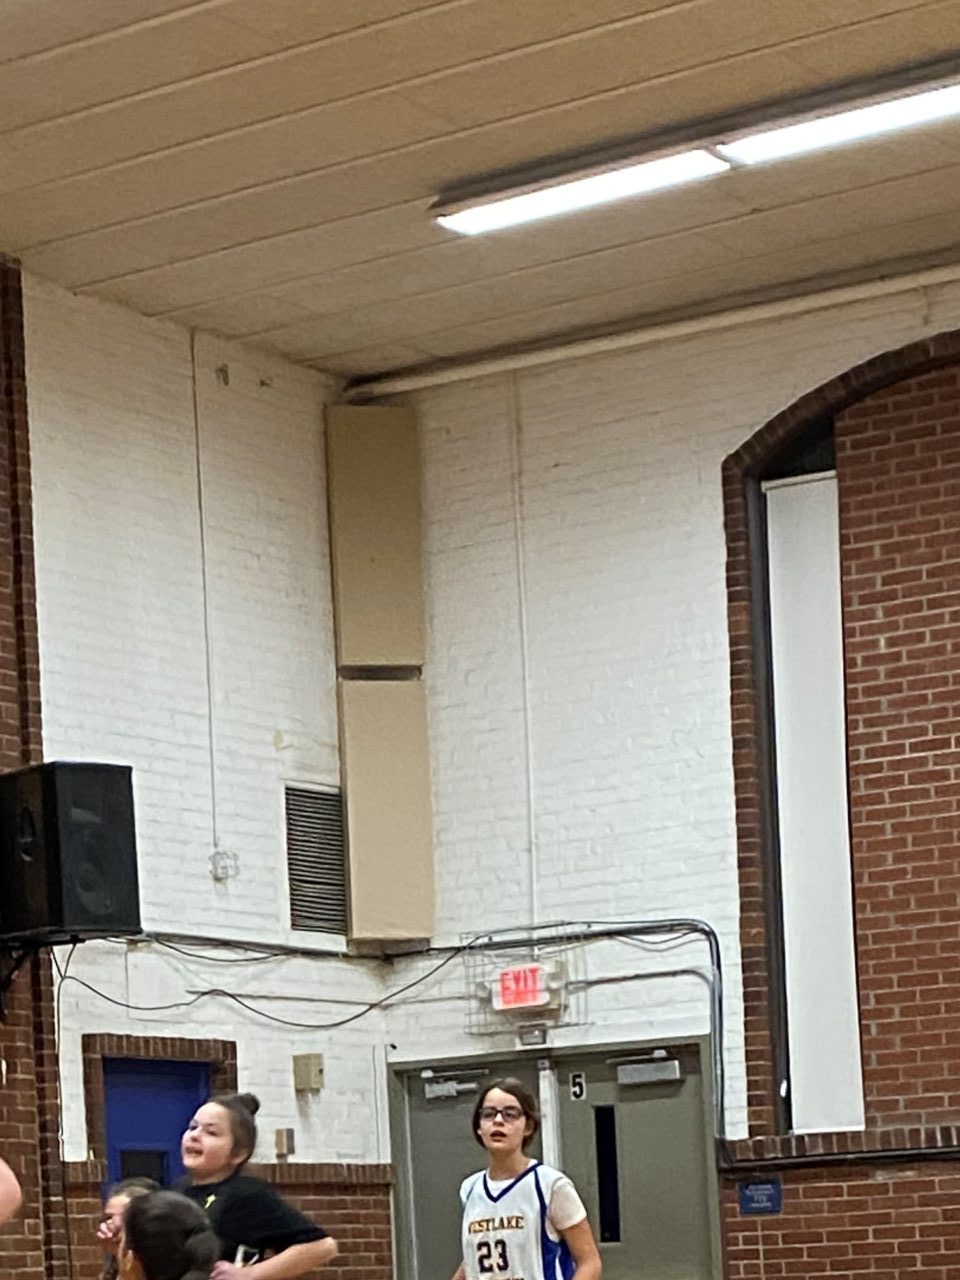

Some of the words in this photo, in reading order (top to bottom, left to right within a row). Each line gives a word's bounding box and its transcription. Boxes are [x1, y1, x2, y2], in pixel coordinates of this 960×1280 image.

[500, 967, 540, 1004] EXIT
[571, 1073, 584, 1100] 5
[477, 1238, 509, 1273] 23
